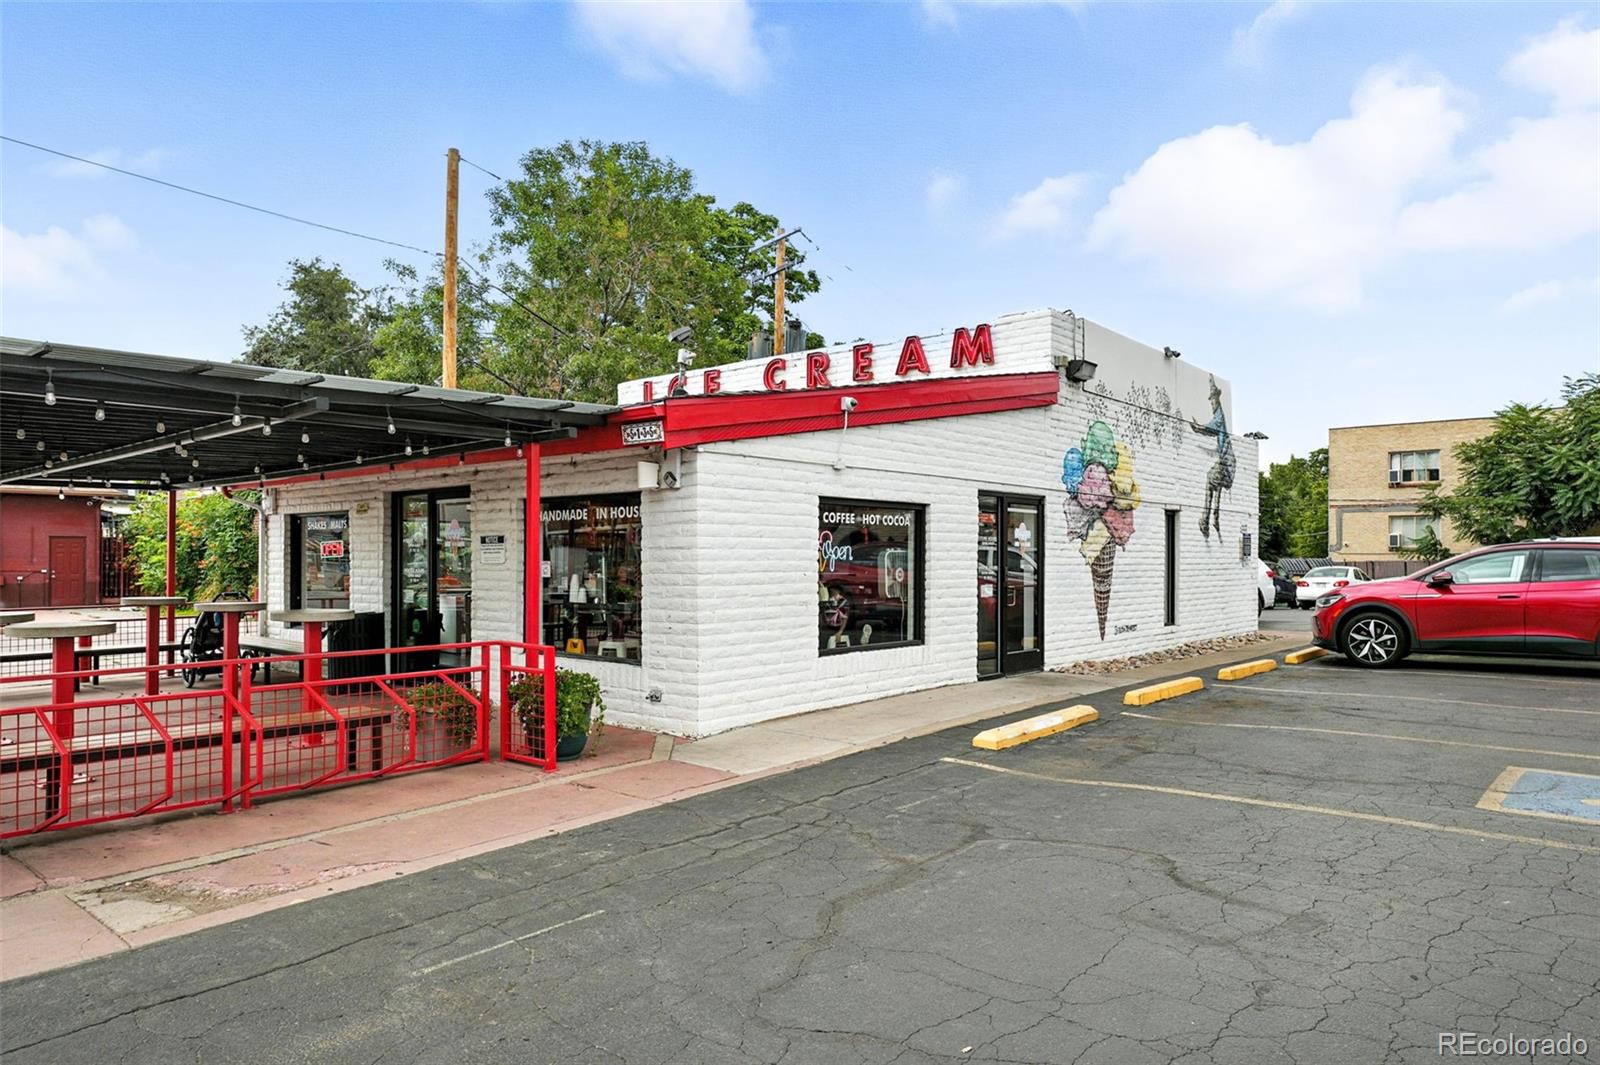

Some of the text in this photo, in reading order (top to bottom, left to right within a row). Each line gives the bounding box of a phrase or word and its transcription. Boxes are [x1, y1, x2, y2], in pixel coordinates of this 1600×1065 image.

[763, 323, 995, 391] CREAM
[596, 507, 608, 519] IN
[610, 506, 639, 519] HOUS
[823, 512, 911, 526] COFFEE HOT COCOA
[307, 519, 347, 530] SHAKES MALTS
[822, 540, 853, 572] Open
